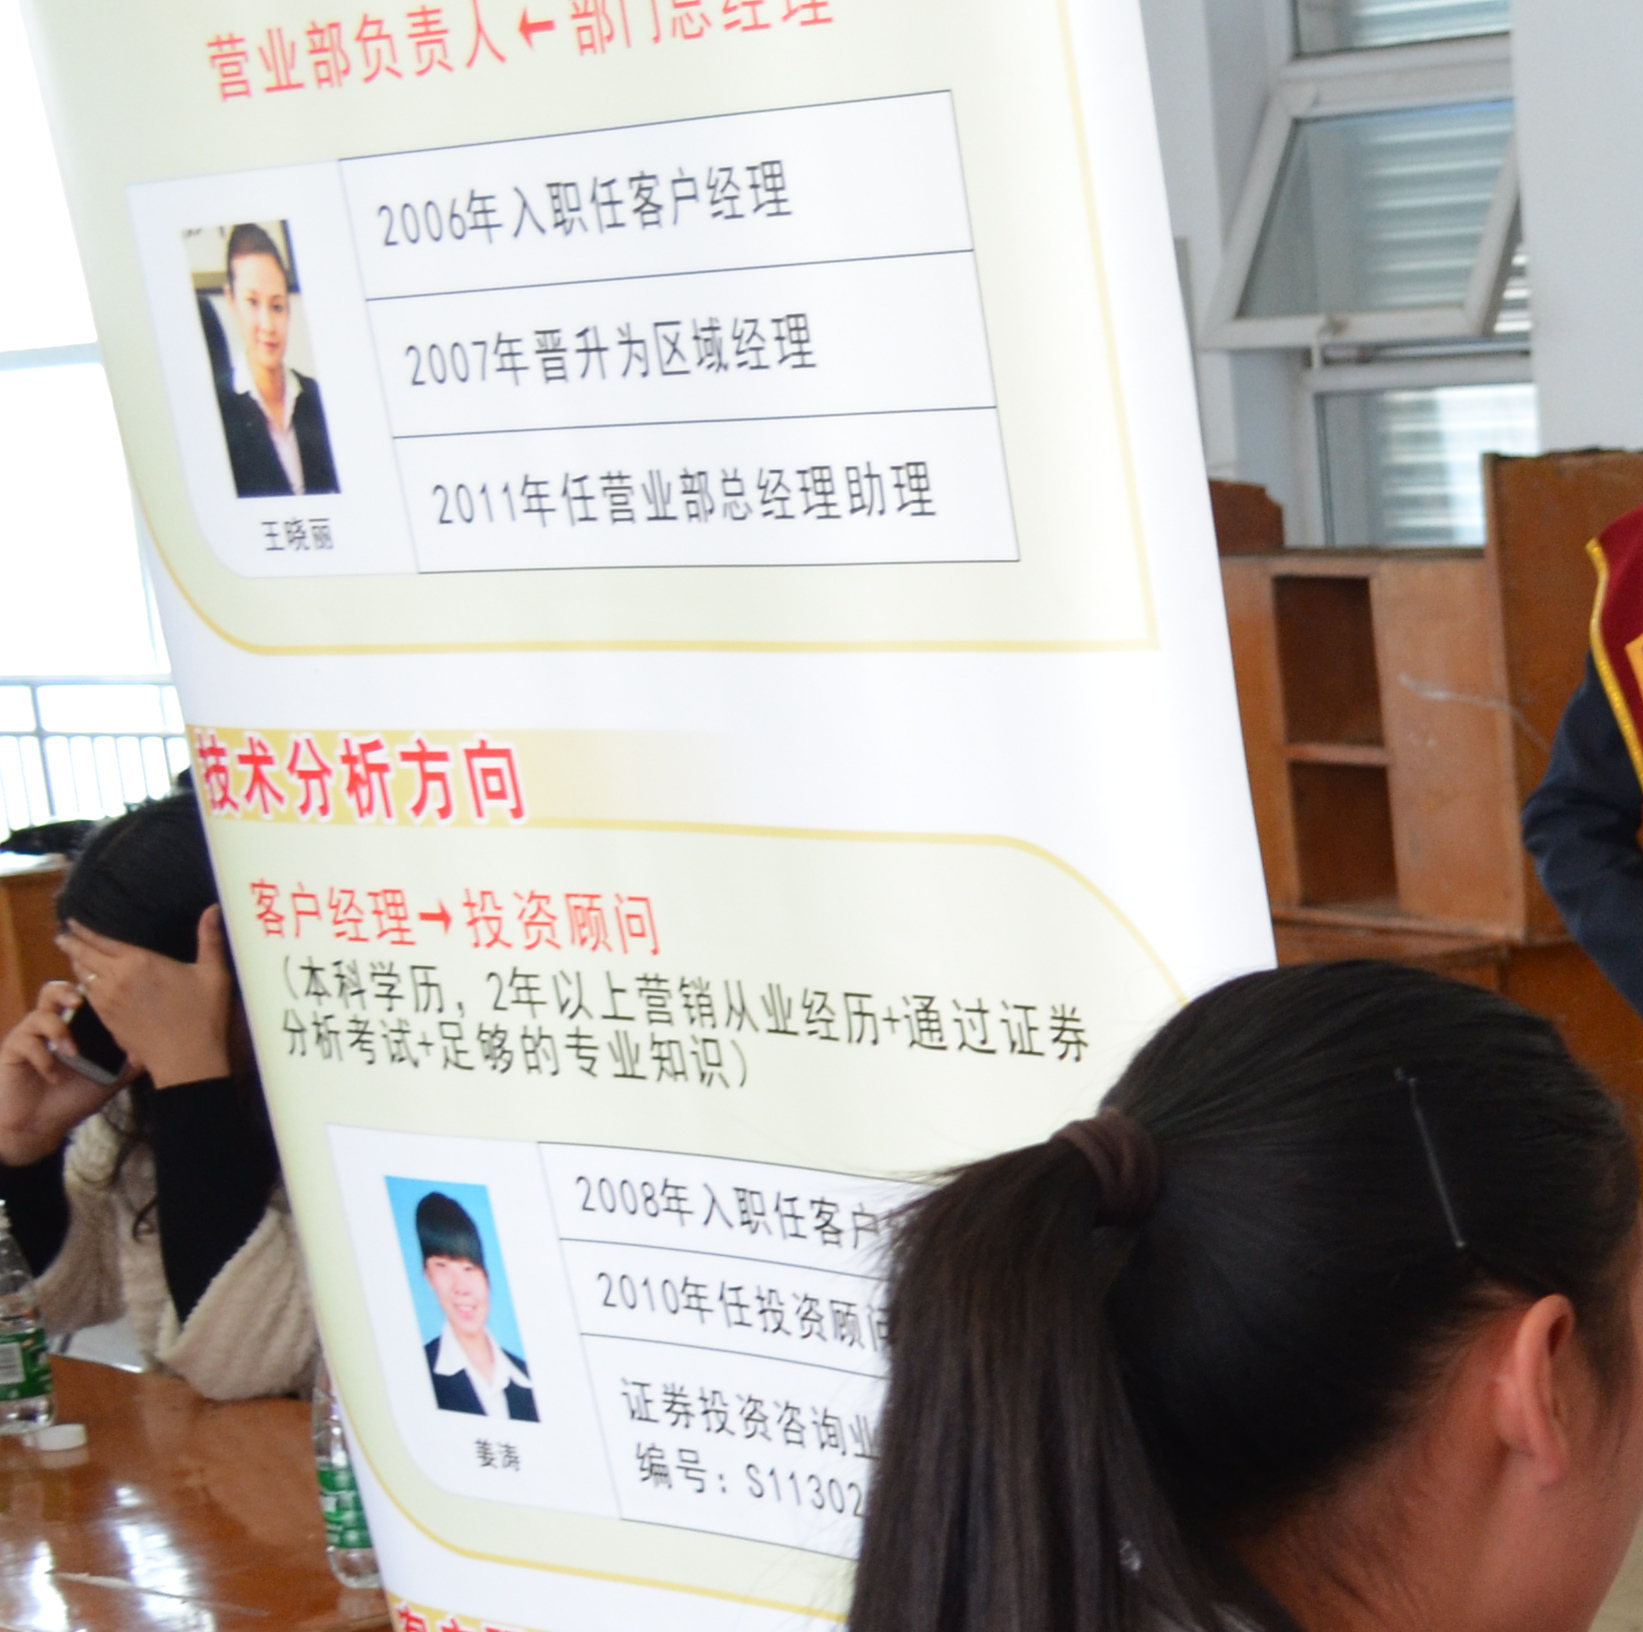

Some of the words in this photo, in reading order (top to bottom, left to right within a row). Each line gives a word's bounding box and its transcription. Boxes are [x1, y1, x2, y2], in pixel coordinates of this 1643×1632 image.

[207, 0, 507, 101] 营业部负责人
[377, 158, 793, 248] 2006年入职任客户经理
[406, 312, 818, 387] 2007年晋升为区域经理
[431, 459, 937, 527] 2011年任营业部总经理助理
[261, 518, 334, 551] 王晓丽
[197, 732, 526, 820] 技术分析方向
[250, 878, 417, 946] 客户经理
[463, 886, 660, 957] 投资顾问
[574, 1174, 903, 1252] 2008年入职任客户
